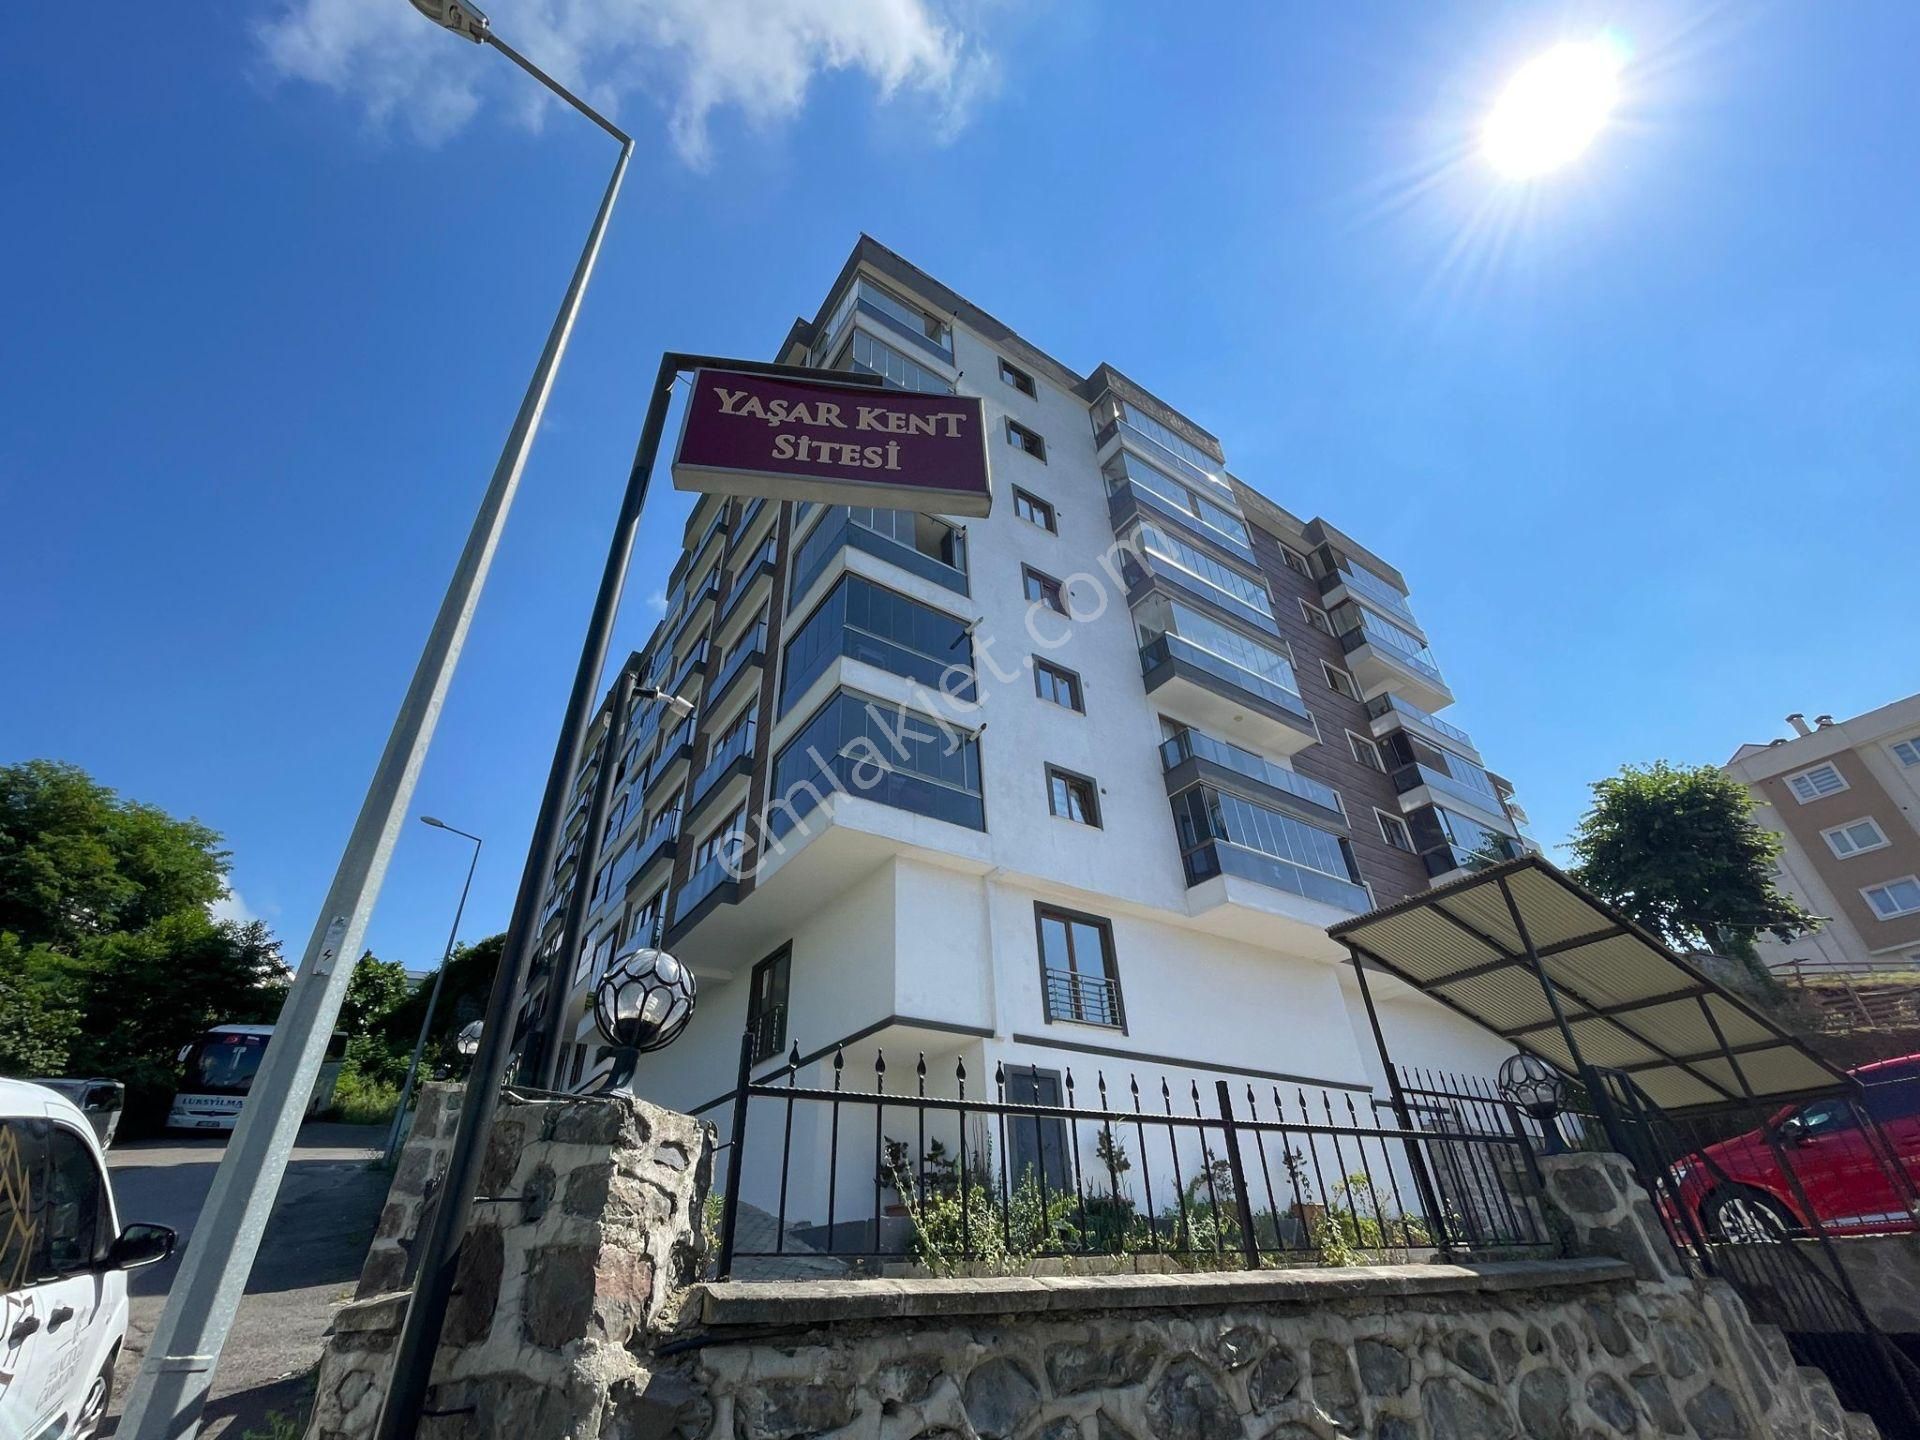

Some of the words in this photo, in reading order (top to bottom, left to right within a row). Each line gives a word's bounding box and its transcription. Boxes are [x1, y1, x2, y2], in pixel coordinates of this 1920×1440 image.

[713, 388, 848, 428] YAŞAR
[856, 406, 967, 438] KENT
[772, 434, 902, 470] SİTESİ
